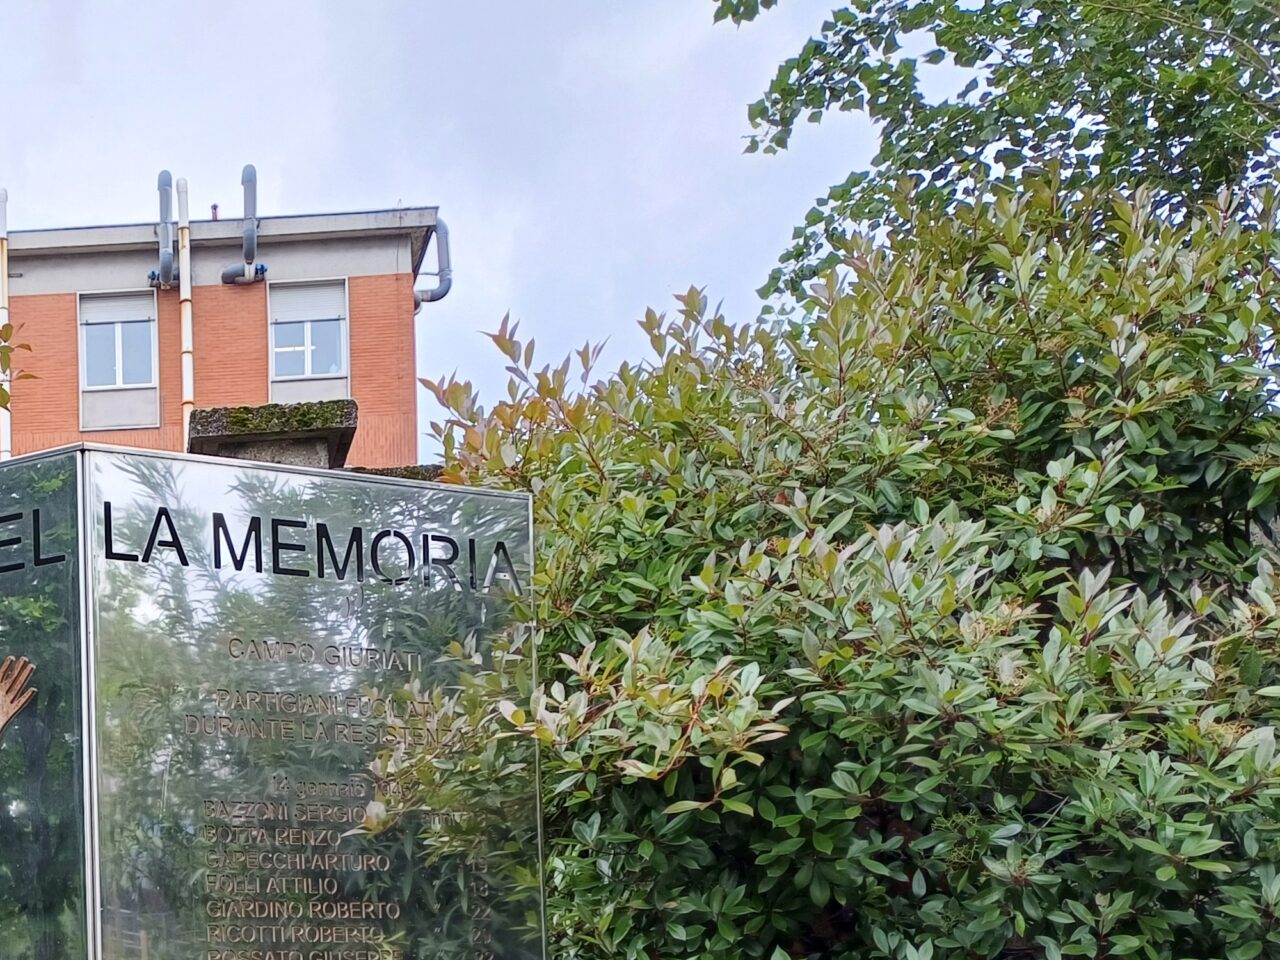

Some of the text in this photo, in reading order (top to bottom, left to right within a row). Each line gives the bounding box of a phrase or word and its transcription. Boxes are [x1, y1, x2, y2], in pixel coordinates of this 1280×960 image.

[103, 501, 524, 597] LA MEMORIA
[228, 638, 423, 673] CAMPO GIURIATI
[215, 688, 437, 721] PARTIGIANI FUCILATI
[184, 713, 467, 750] DURANTE LA RESISTENZA
[271, 774, 291, 795] 14
[294, 778, 367, 800] gennaio
[203, 799, 289, 822] BAZZONI
[293, 803, 368, 823] SERGIO
[204, 824, 269, 845] BOTTA
[275, 828, 342, 847] RENZO
[205, 850, 306, 870] CAPECCHI
[310, 852, 391, 872] ARTURO
[205, 875, 260, 894] FOLLI
[266, 877, 338, 896] ATTILIO
[206, 900, 303, 919] GIARDINO
[308, 901, 401, 919] ROBERTO
[206, 924, 285, 943] RICOTTI
[291, 925, 385, 943] ROBERTO
